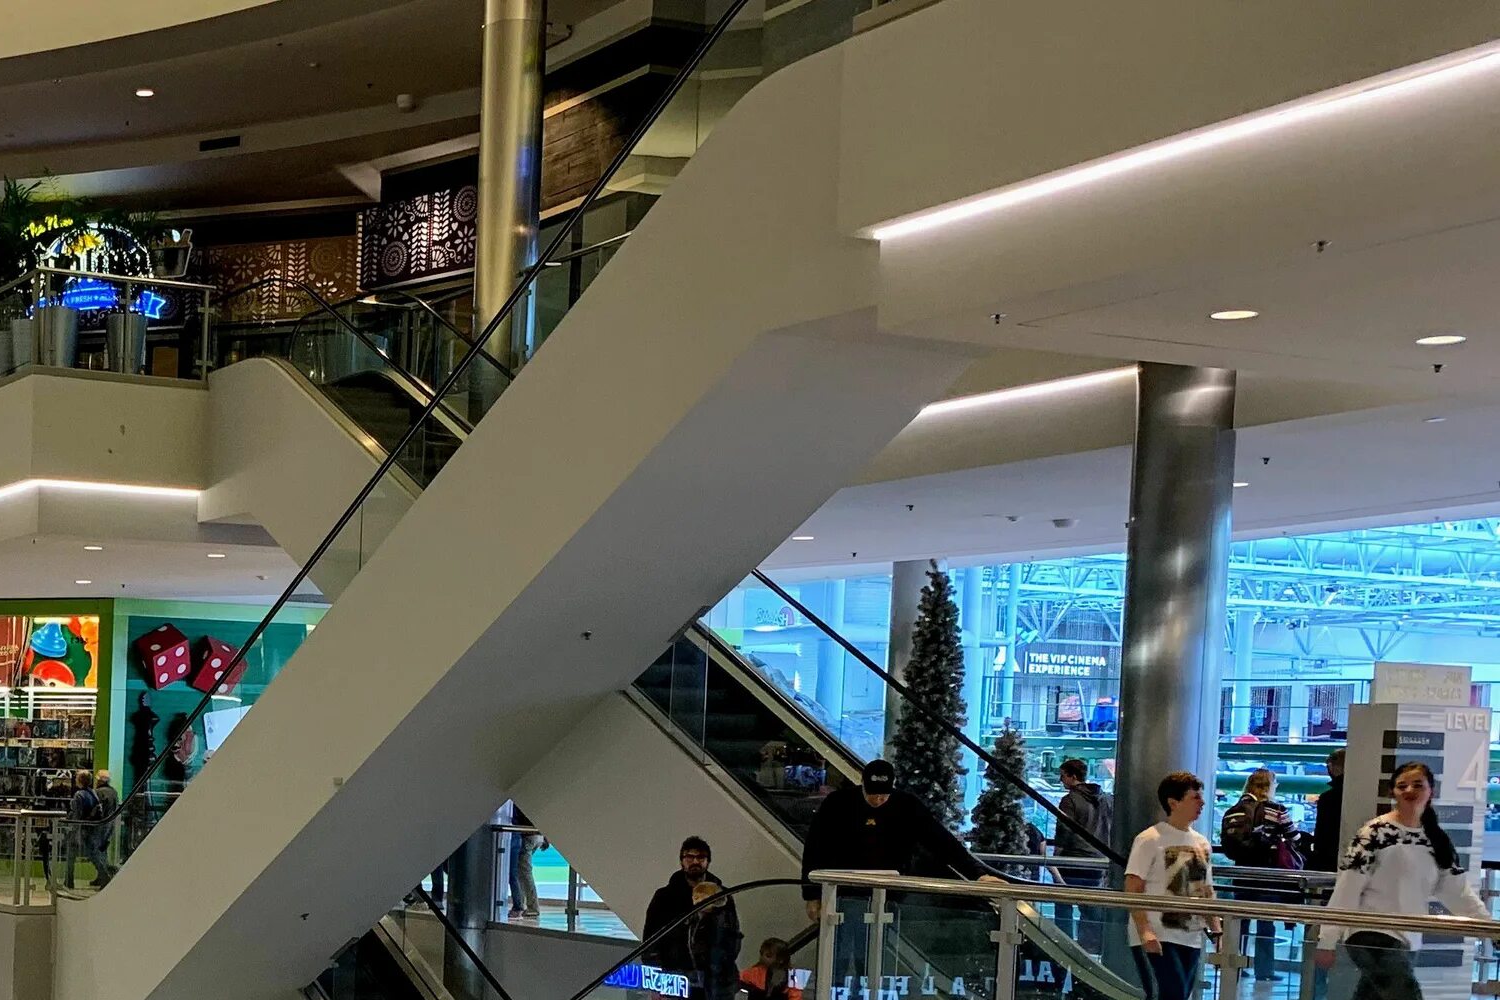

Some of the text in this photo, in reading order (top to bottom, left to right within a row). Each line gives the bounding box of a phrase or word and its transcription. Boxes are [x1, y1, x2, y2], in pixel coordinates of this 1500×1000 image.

[1029, 652, 1107, 666] THE VIP CINEMA
[1028, 664, 1091, 676] EXPERIENCE
[1445, 712, 1490, 732] LEVEL
[1456, 738, 1488, 801] 4
